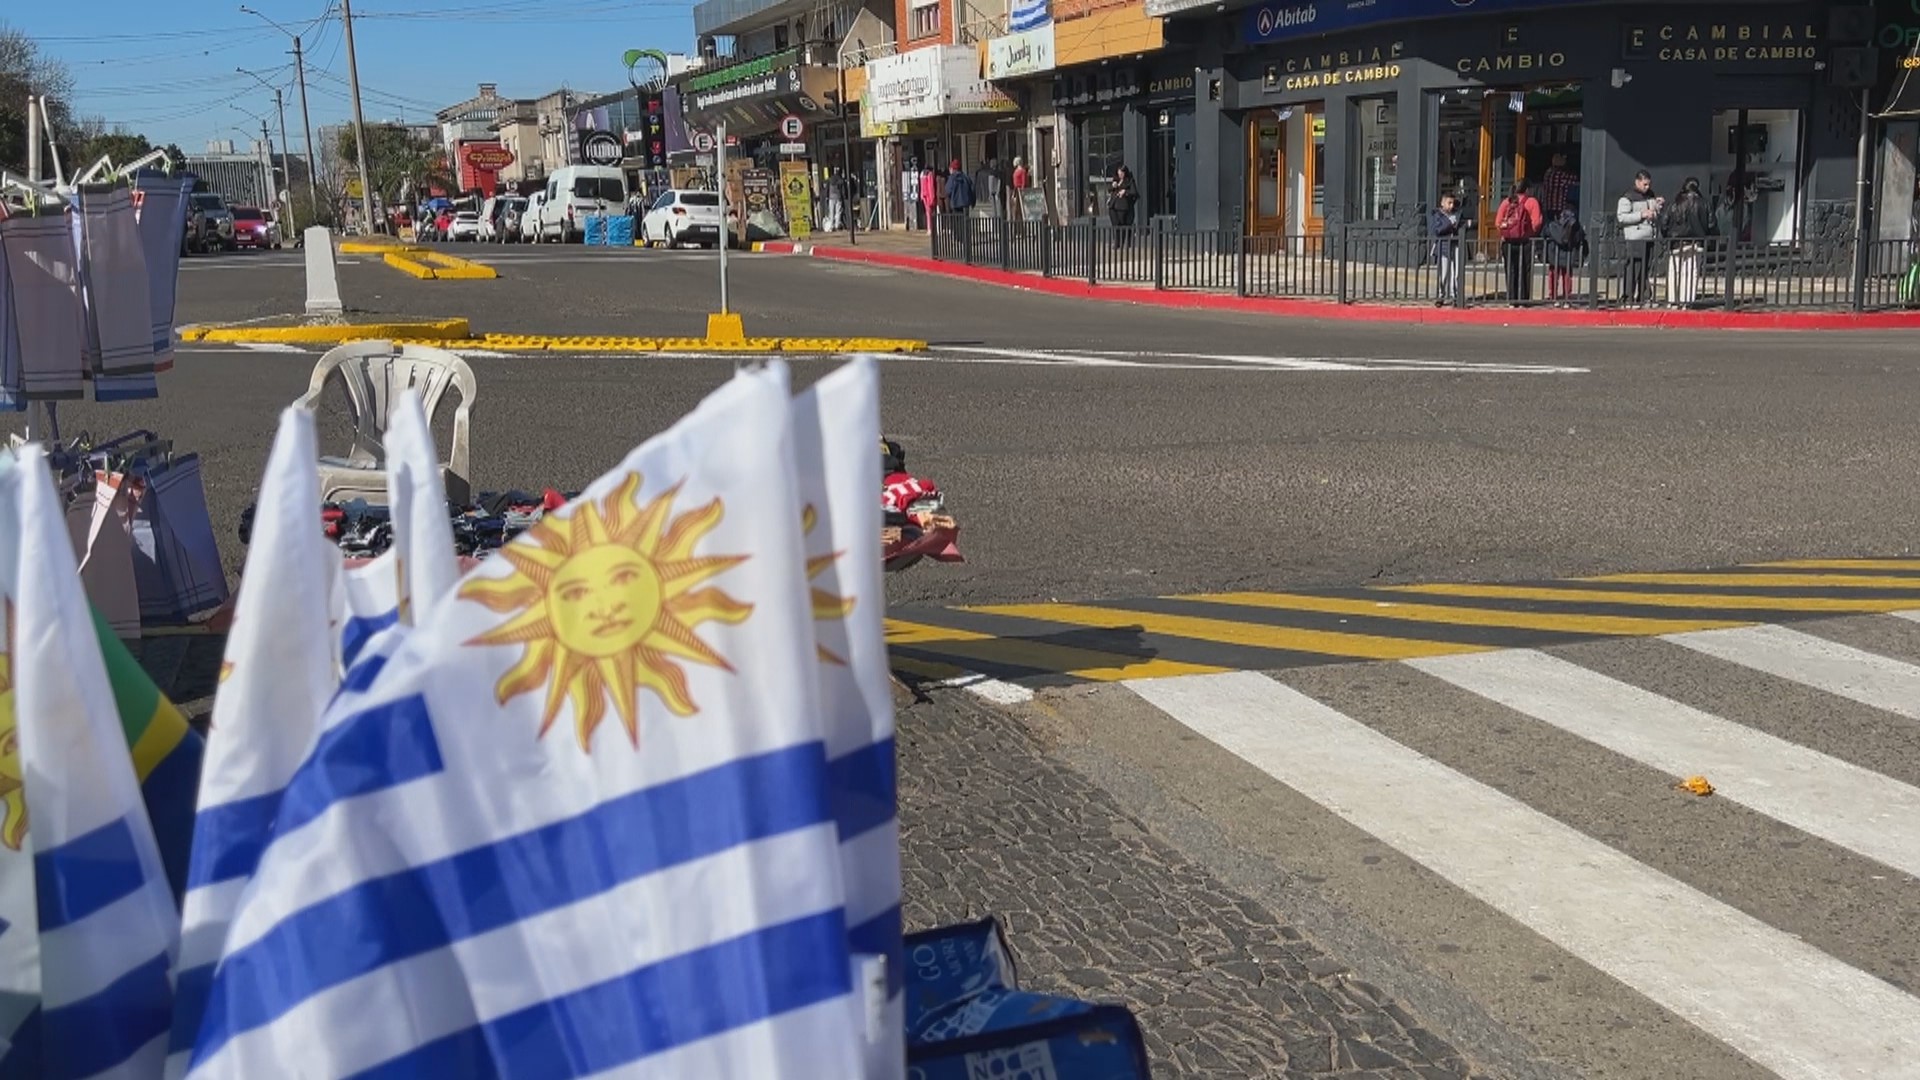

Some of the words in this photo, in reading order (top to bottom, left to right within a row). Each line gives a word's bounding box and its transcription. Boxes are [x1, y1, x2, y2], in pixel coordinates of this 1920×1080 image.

[1274, 4, 1317, 28] Abitab
[1659, 25, 1817, 41] CAMBIAL
[1658, 47, 1708, 61] CASA
[1714, 47, 1739, 60] DE
[1744, 46, 1817, 60] CAMBIO
[1456, 52, 1565, 73] CAMBIO
[1149, 77, 1193, 93] CAMBIO
[1286, 74, 1320, 91] CASA
[1323, 71, 1341, 85] DE
[1345, 64, 1401, 82] CAMBIO
[787, 119, 798, 134] E
